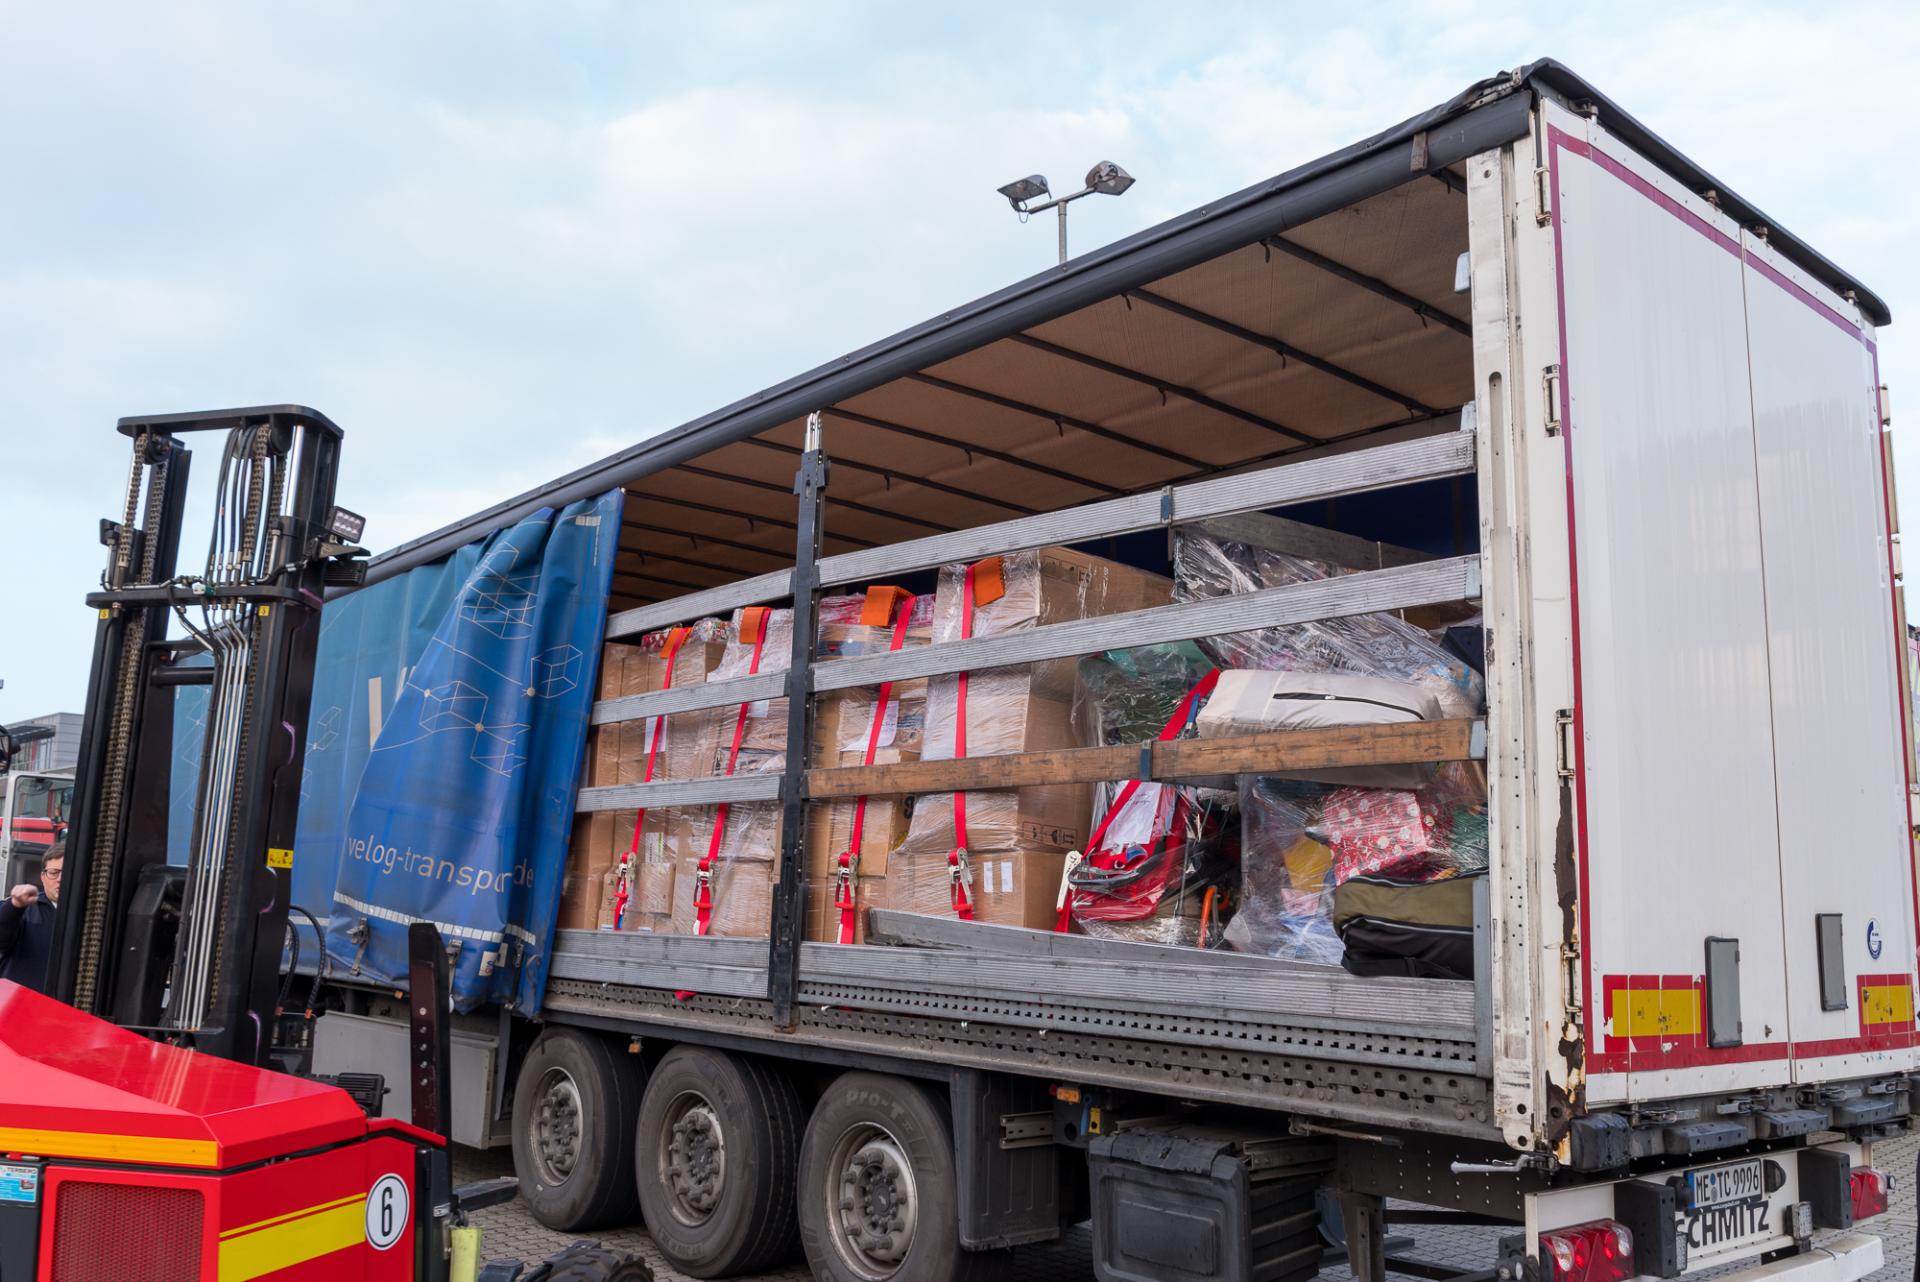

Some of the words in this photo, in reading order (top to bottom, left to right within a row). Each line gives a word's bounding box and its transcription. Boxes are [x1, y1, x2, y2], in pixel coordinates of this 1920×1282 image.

[1696, 1175, 1710, 1203] ME
[1717, 1171, 1731, 1198] TC
[1733, 1166, 1759, 1195] 9996
[381, 1186, 393, 1237] 6
